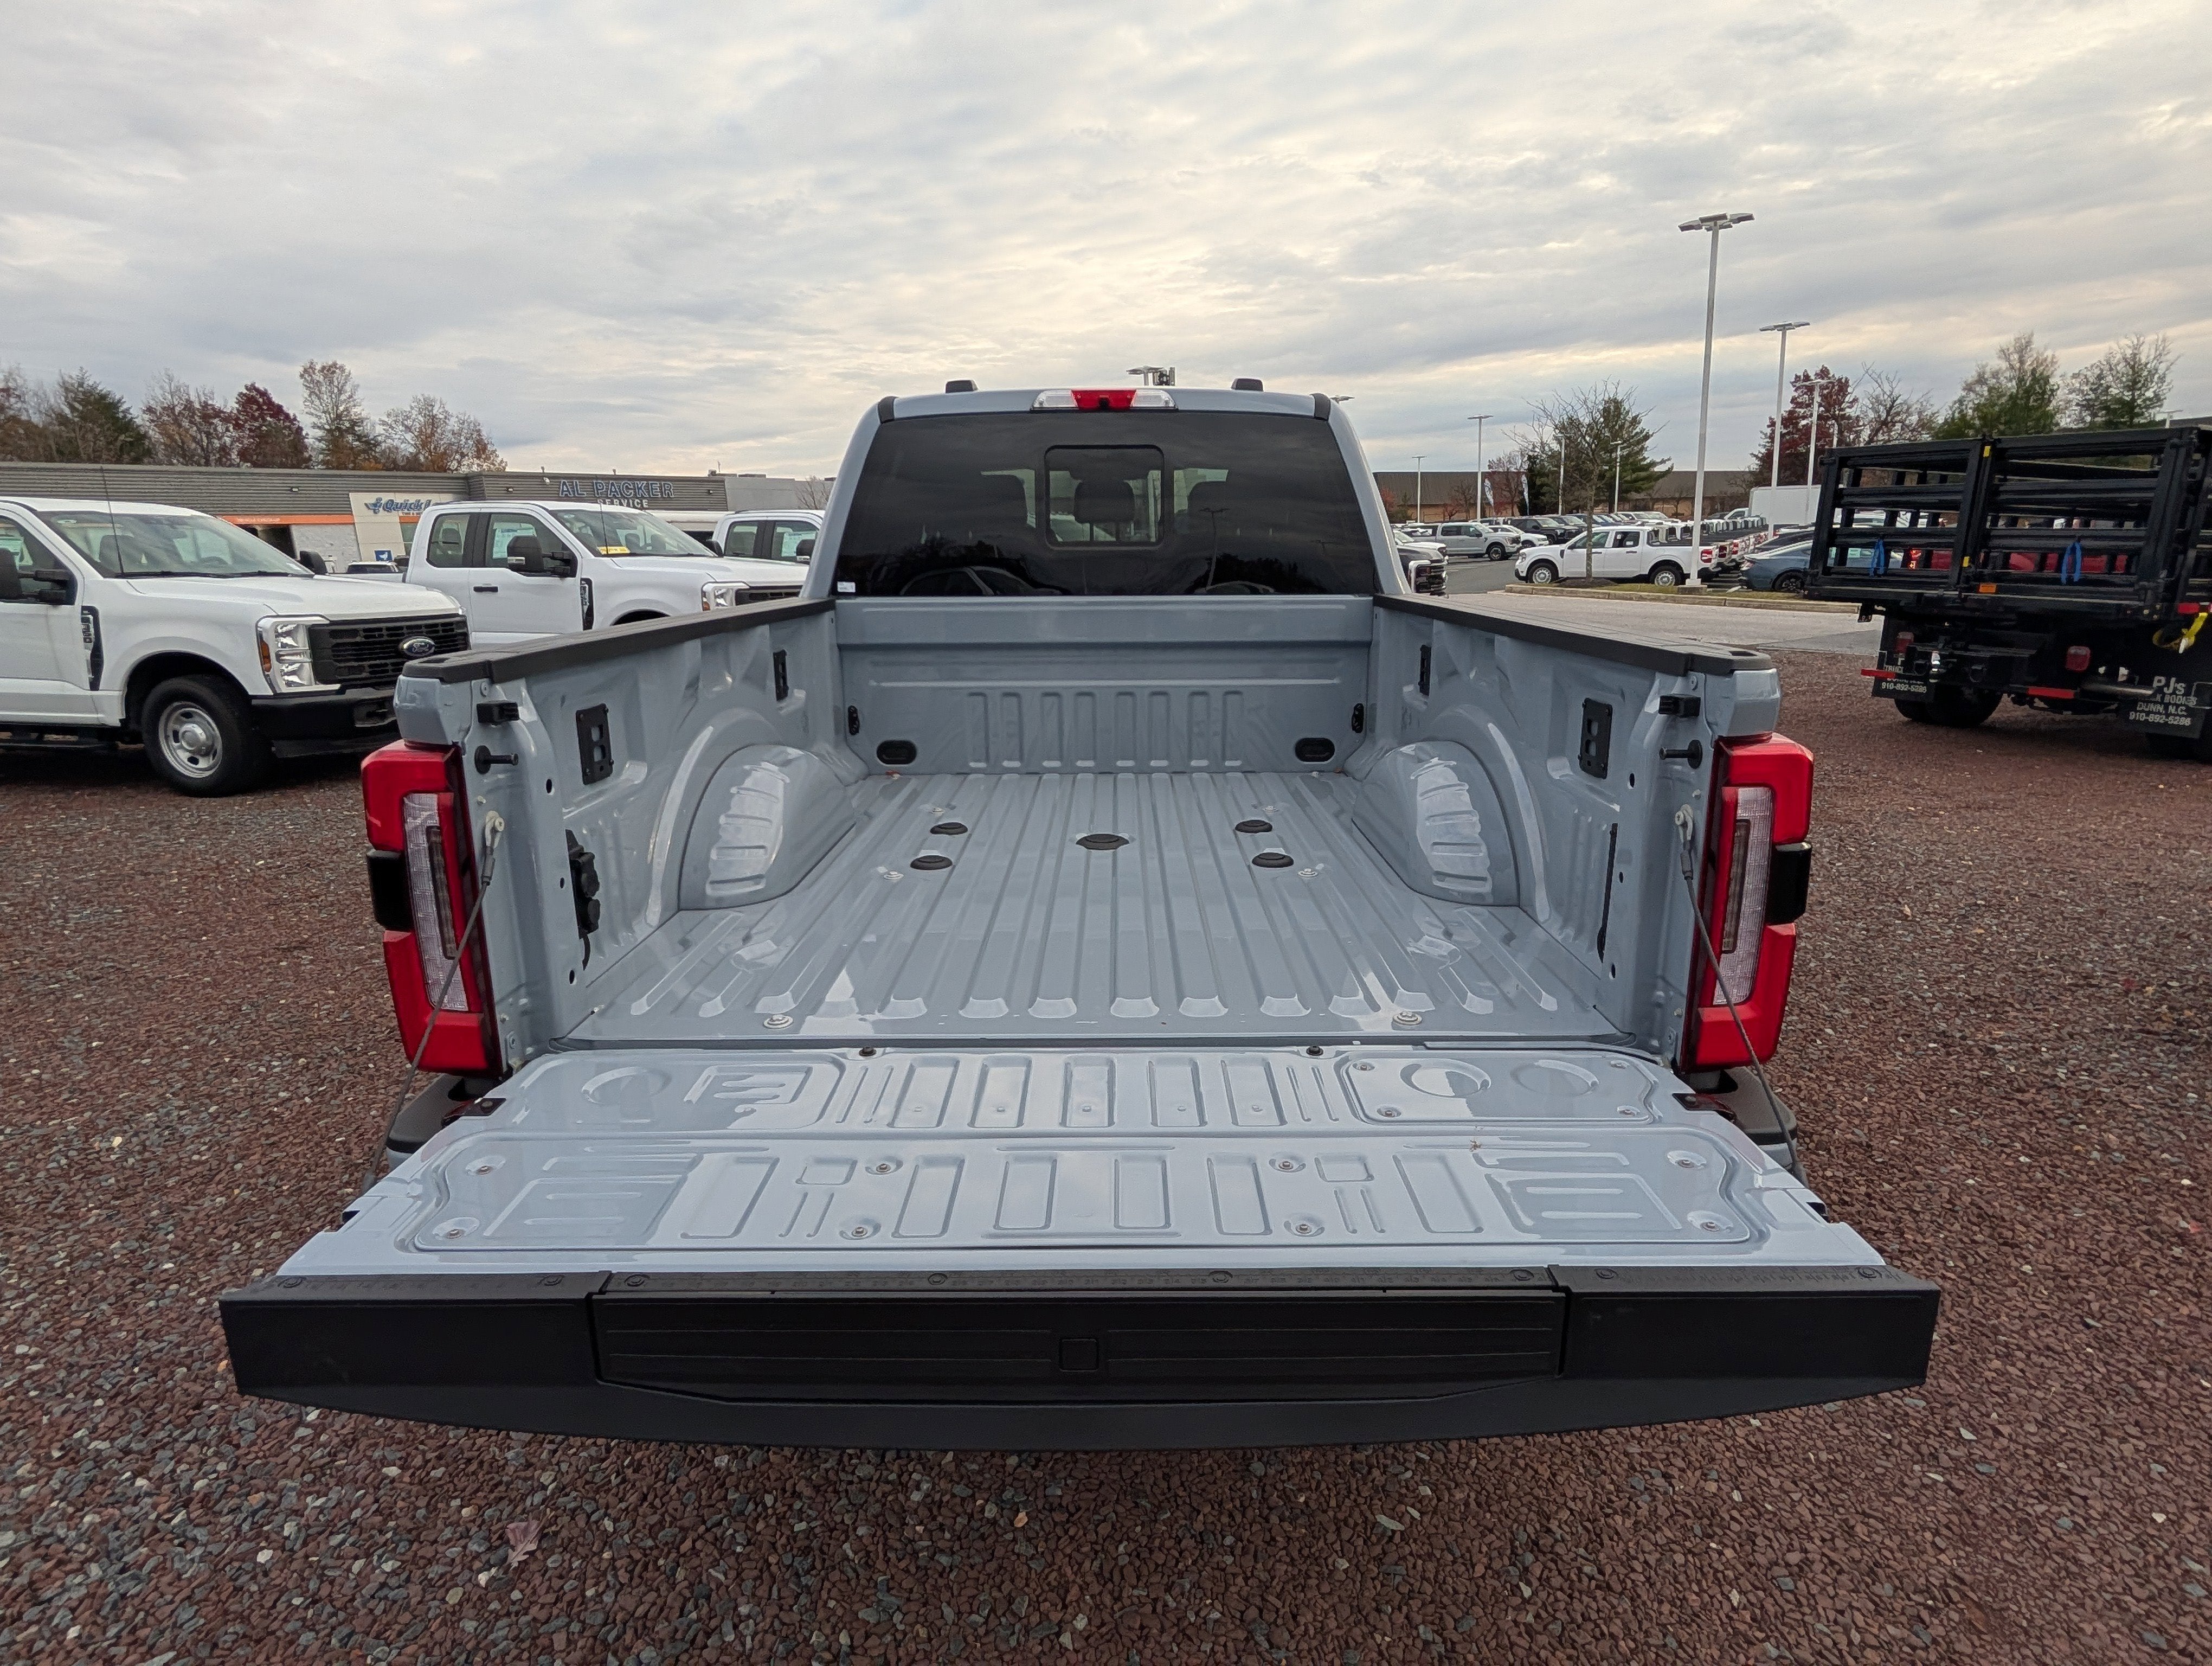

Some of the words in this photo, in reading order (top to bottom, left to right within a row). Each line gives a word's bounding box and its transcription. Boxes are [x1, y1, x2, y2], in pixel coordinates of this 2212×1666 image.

[559, 480, 587, 497] AL
[593, 480, 674, 498] PACKER
[382, 499, 425, 512] Quick
[597, 499, 649, 508] SERVICE
